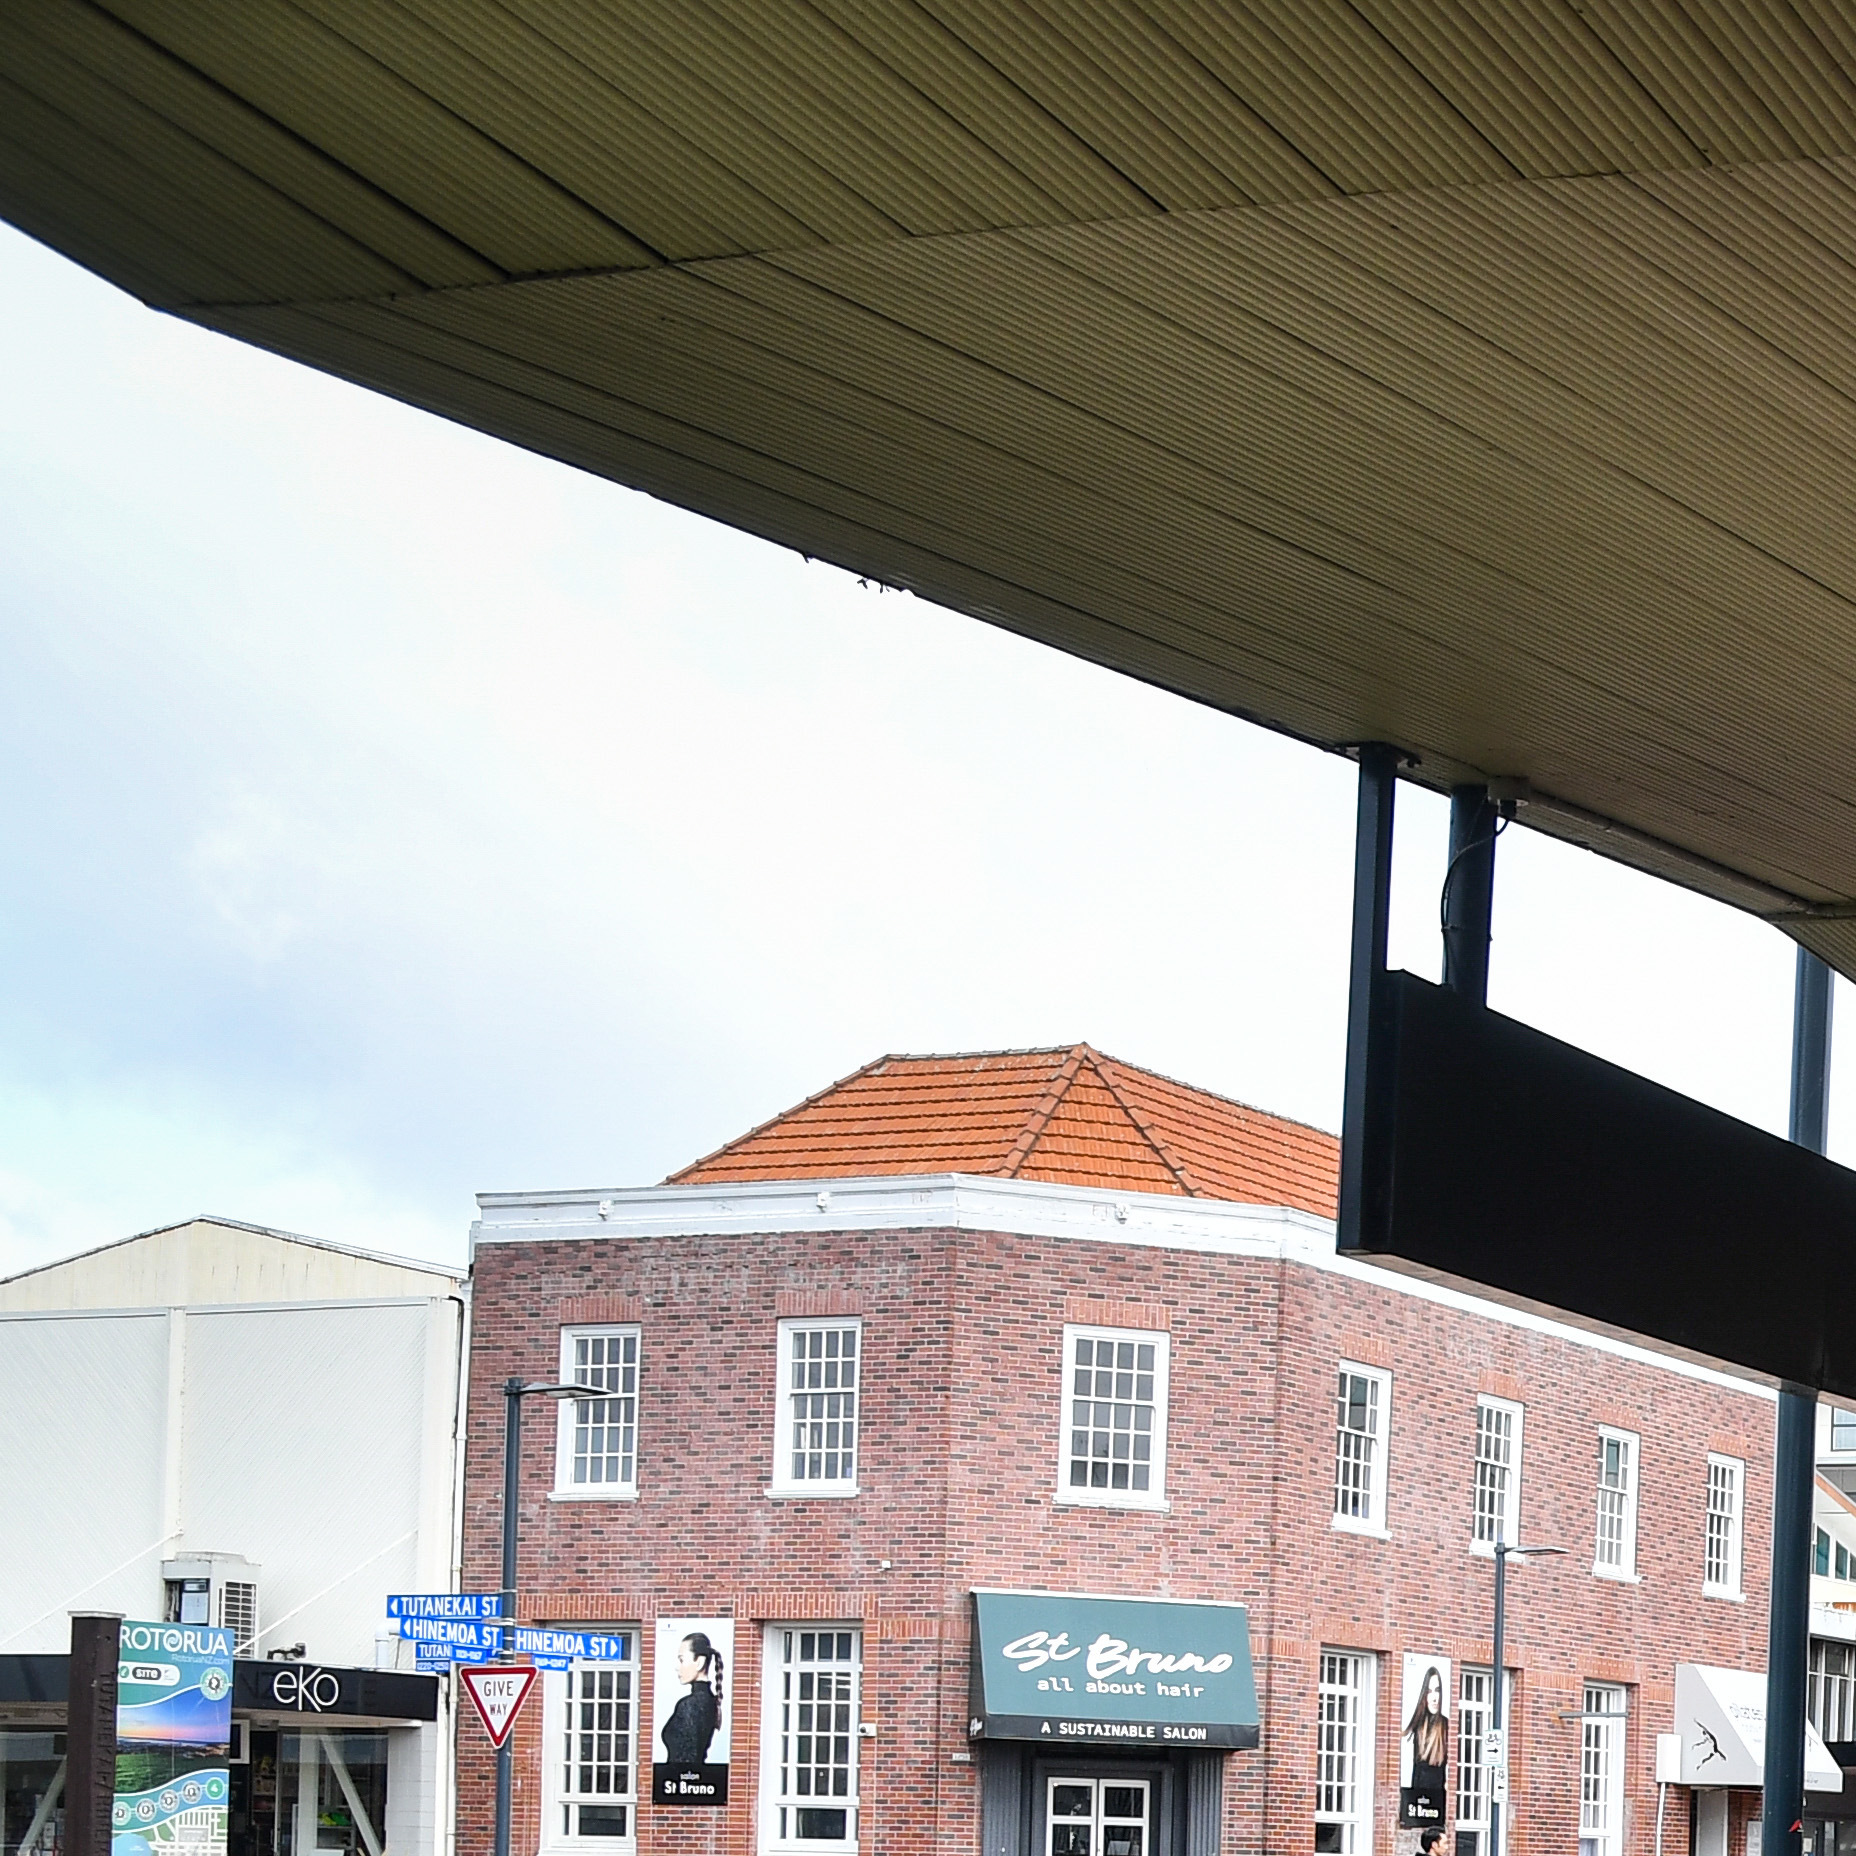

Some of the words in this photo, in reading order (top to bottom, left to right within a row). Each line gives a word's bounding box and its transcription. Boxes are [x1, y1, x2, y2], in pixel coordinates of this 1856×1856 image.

[400, 1596, 477, 1617] TUTANEKAI
[481, 1596, 499, 1616] ST
[119, 1625, 229, 1656] ROTORUA
[412, 1618, 478, 1645] HINEMOA
[482, 1626, 500, 1647] ST
[515, 1629, 586, 1655] HINEMOA
[590, 1636, 609, 1657] ST
[418, 1643, 451, 1657] TUTAN
[1002, 1630, 1081, 1673] St
[1086, 1633, 1234, 1681] Bruno
[483, 1680, 514, 1697] GIVE
[1037, 1676, 1074, 1693] all
[1086, 1680, 1147, 1696] about
[1157, 1681, 1206, 1698] hair
[489, 1703, 508, 1716] WAY
[1041, 1722, 1052, 1735] A
[1059, 1722, 1156, 1739] SUSTAINABLE
[1163, 1726, 1207, 1741] SALON
[664, 1780, 677, 1794] St
[680, 1780, 715, 1795] Bruno
